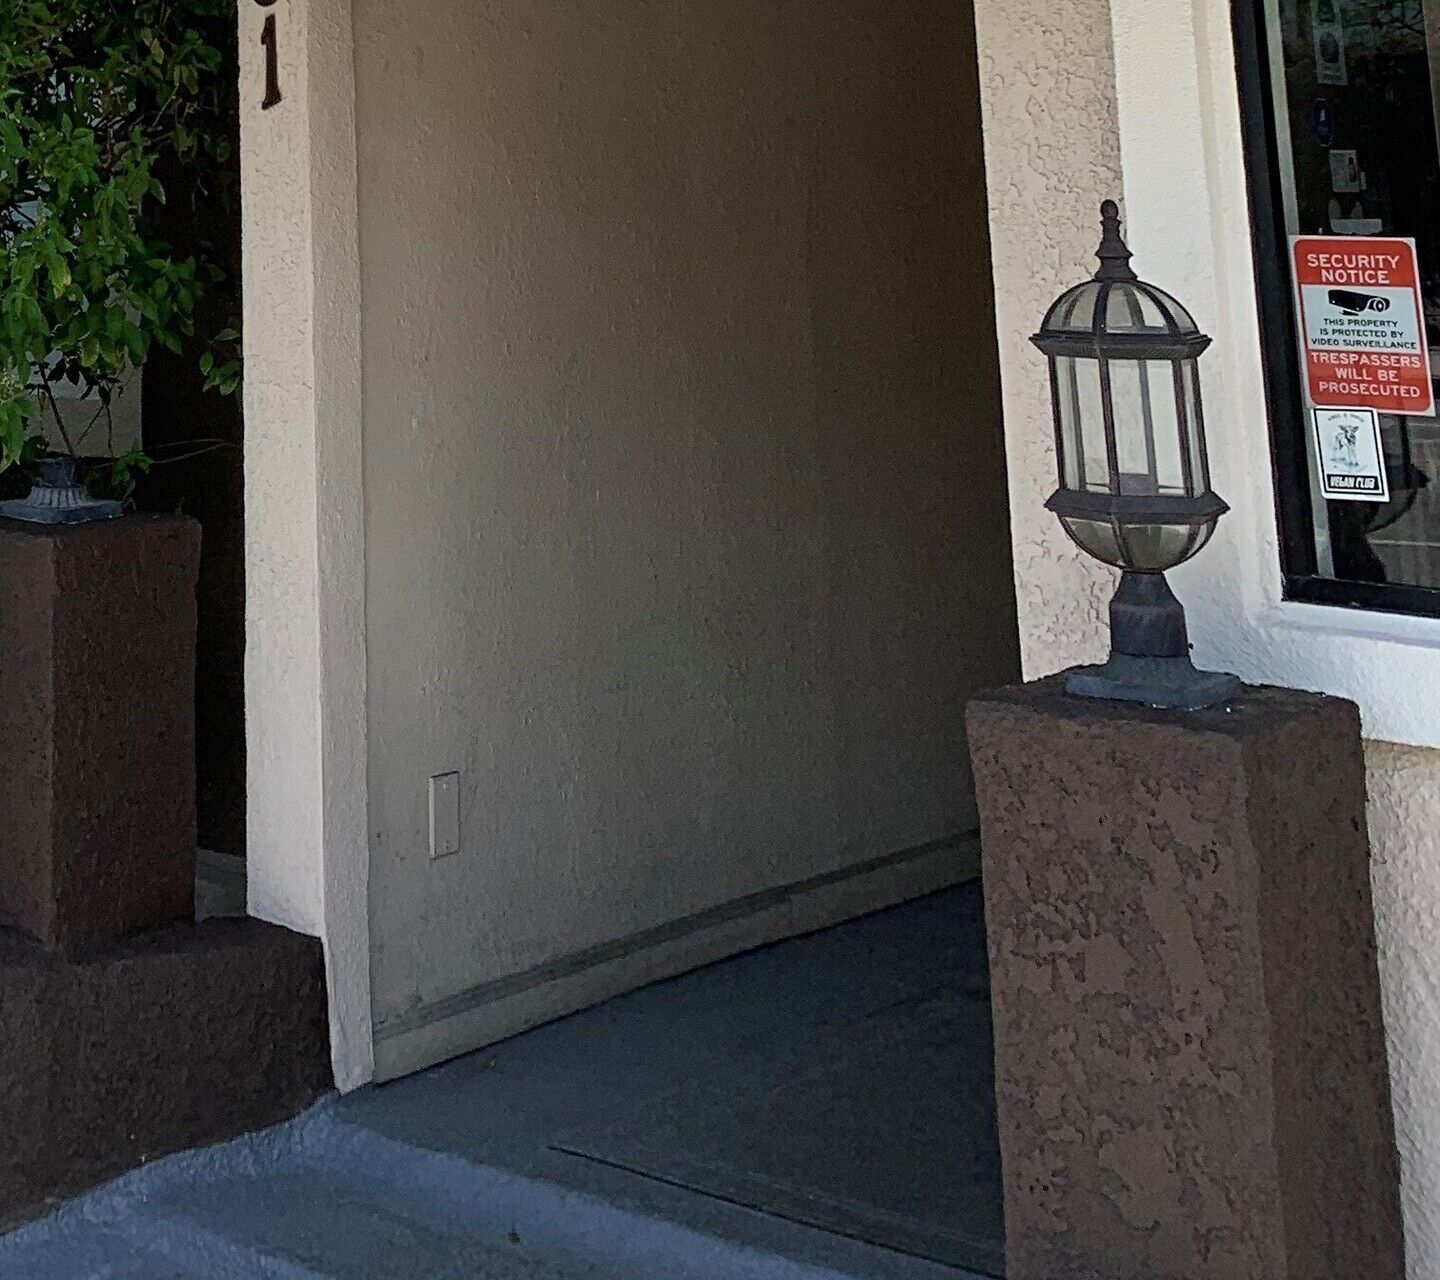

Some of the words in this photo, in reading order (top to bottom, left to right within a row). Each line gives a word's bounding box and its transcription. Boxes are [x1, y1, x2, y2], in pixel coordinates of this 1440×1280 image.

[1306, 253, 1400, 269] SECURITY
[1321, 268, 1390, 284] NOTICE
[1323, 318, 1345, 326] THIS
[1347, 318, 1398, 328] PROPERTY
[1320, 328, 1329, 336] IS
[1331, 328, 1388, 338] PROTECTED
[1390, 330, 1404, 339] BY
[1311, 338, 1340, 346] VIDEO
[1342, 338, 1417, 350] SURVEILLANCE
[1311, 352, 1421, 369] TRESPASSERS
[1334, 367, 1373, 381] WILL
[1377, 369, 1400, 382] BE
[1319, 381, 1421, 398] PROSECUTED
